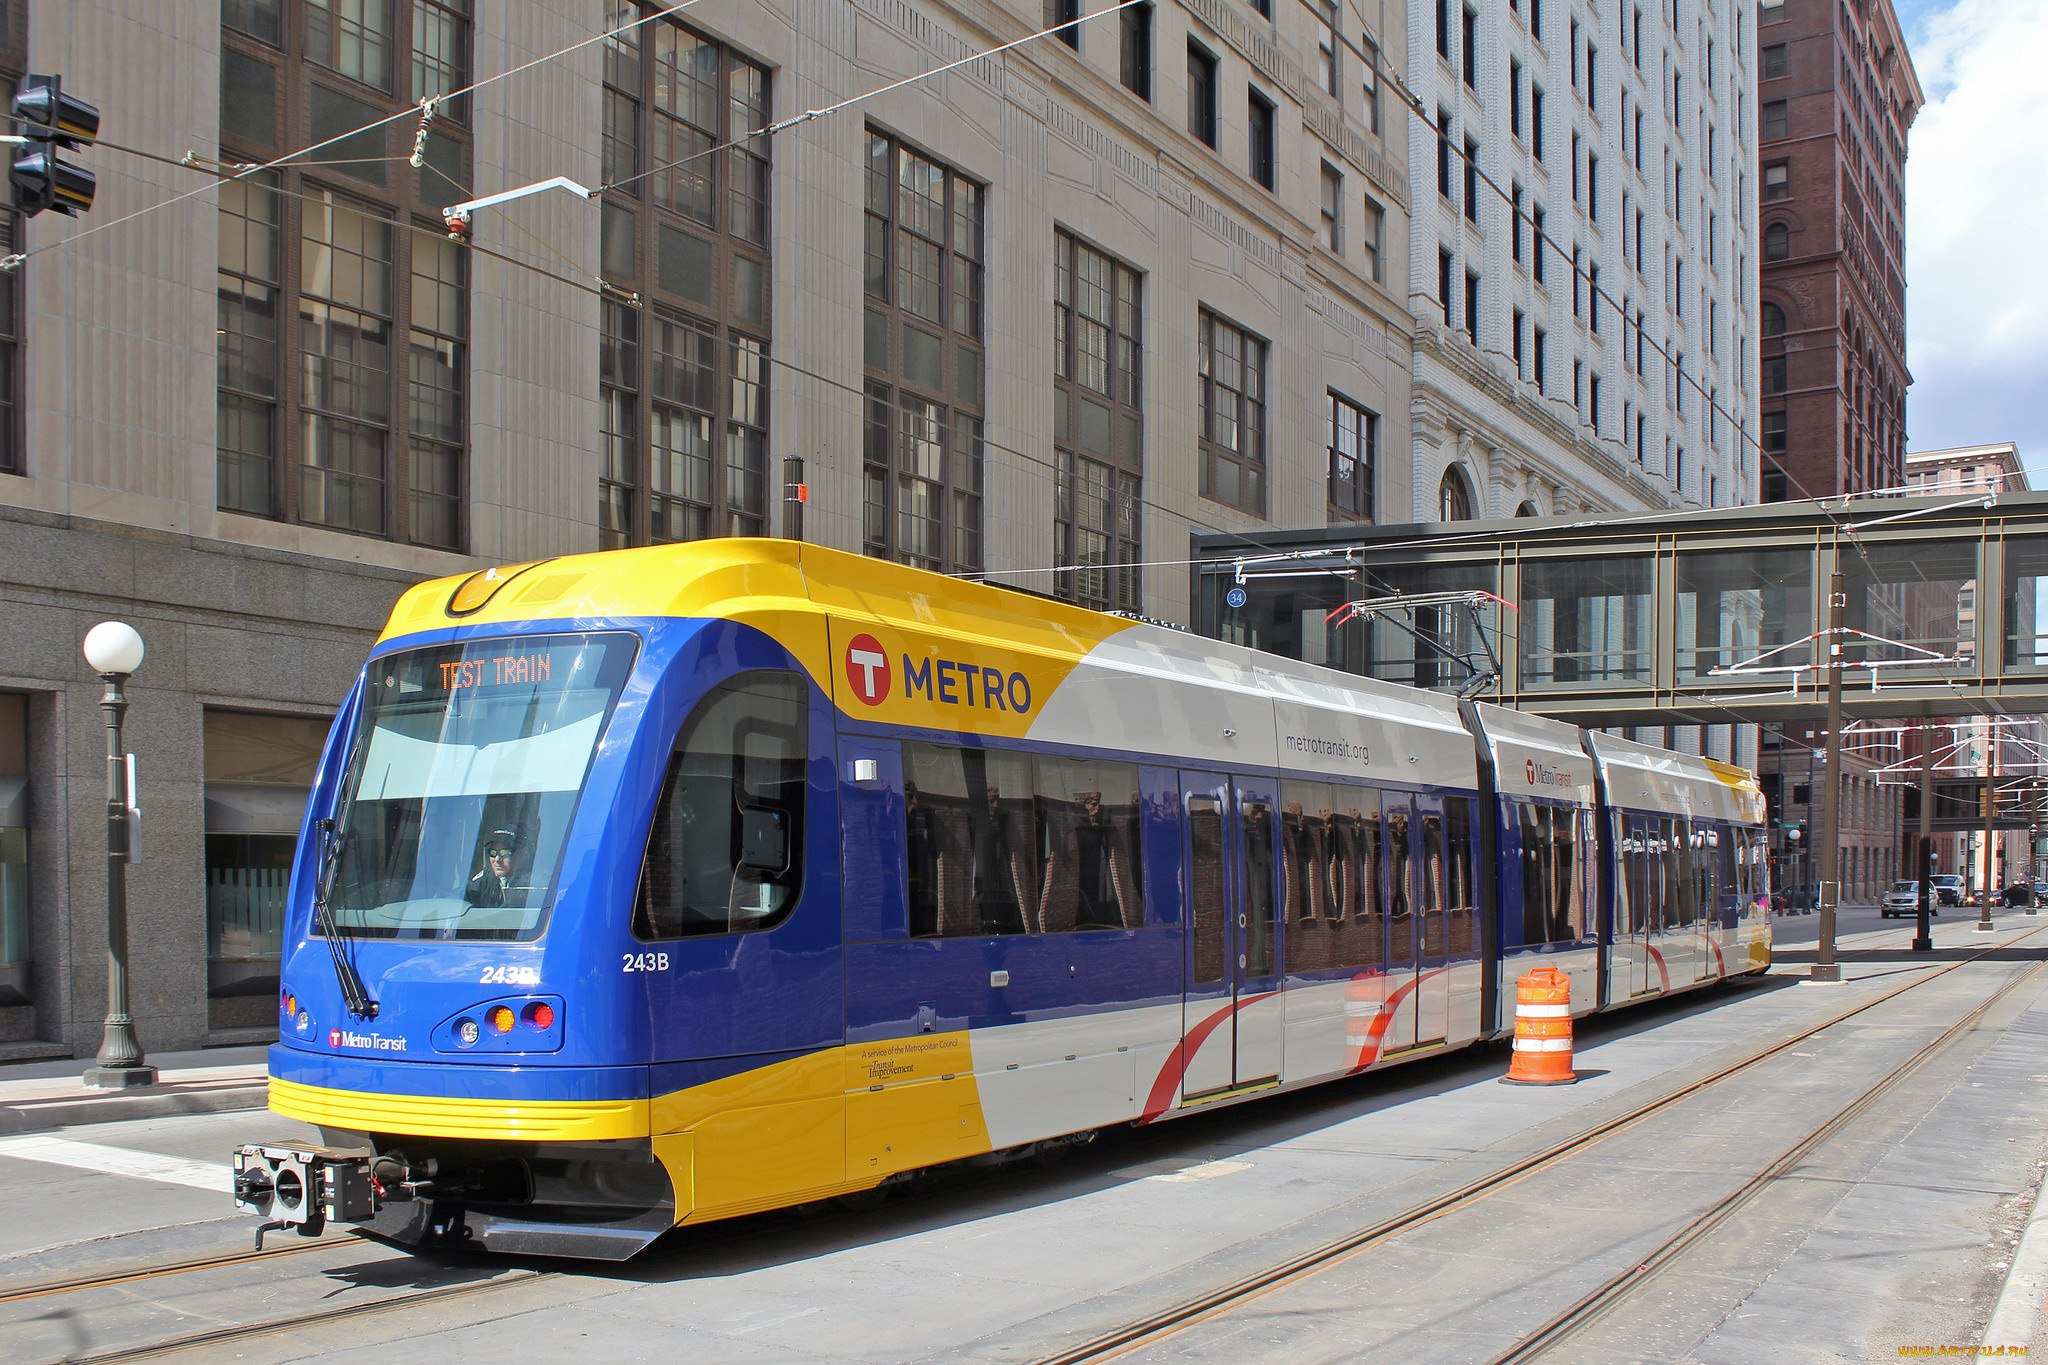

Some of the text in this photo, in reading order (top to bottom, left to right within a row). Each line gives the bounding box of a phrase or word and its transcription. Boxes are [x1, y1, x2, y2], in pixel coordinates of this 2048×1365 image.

[1230, 593, 1243, 603] 34
[439, 653, 551, 690] TEST TRAIN
[903, 653, 1032, 714] METRO
[1286, 734, 1369, 766] metrotransit.org
[622, 952, 670, 974] 243B
[479, 966, 534, 985] 243B
[861, 1038, 959, 1059] A service of the Metropolitan Council
[869, 1064, 914, 1079] Improvement
[872, 1058, 894, 1070] Transit
